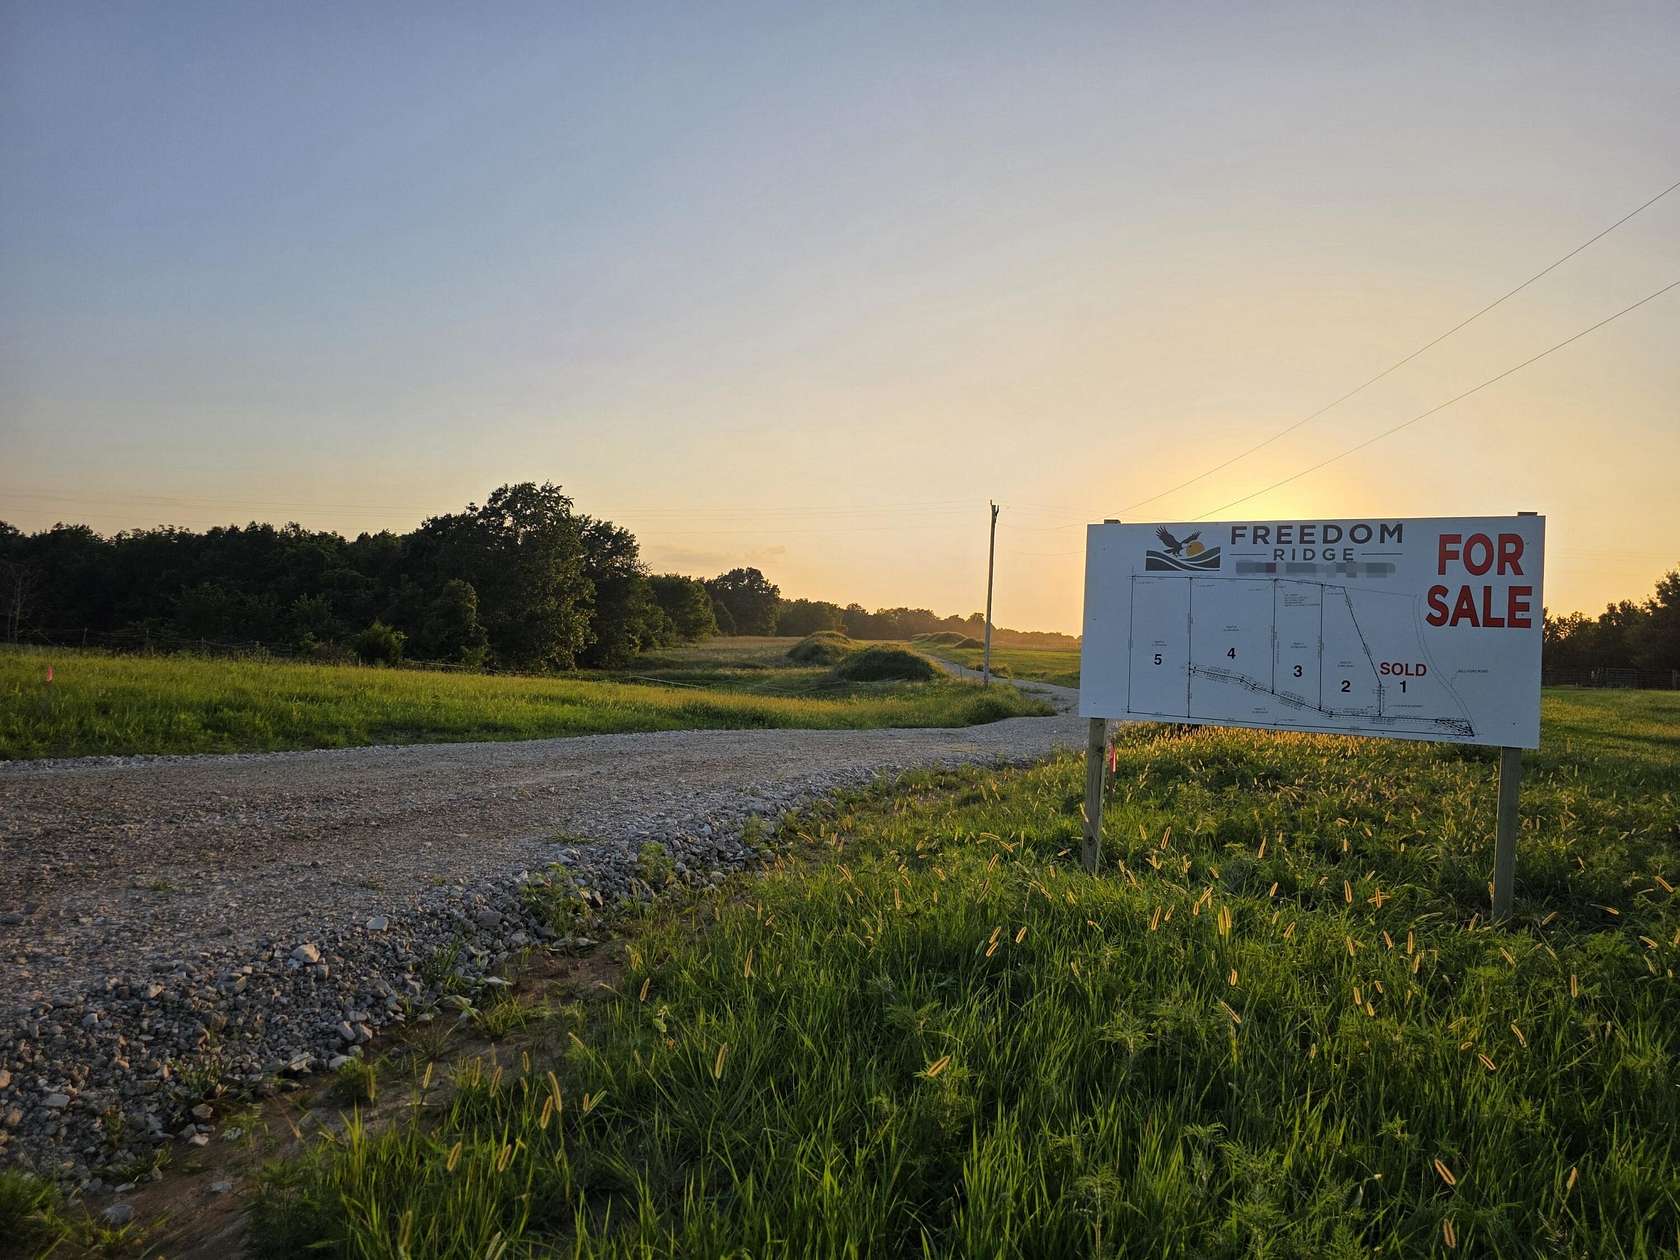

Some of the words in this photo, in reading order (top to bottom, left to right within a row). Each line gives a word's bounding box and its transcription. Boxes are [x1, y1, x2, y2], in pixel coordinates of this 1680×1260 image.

[1230, 523, 1403, 545] FREEDOM
[1273, 548, 1354, 561] RIDGE
[1437, 533, 1524, 576] FOR
[1425, 585, 1533, 628] SALE
[1153, 654, 1162, 666] 5
[1227, 647, 1237, 660] 4
[1293, 665, 1303, 678] 3
[1379, 662, 1428, 677] SOLD
[1341, 680, 1351, 693] 2
[1399, 681, 1407, 693] 1
